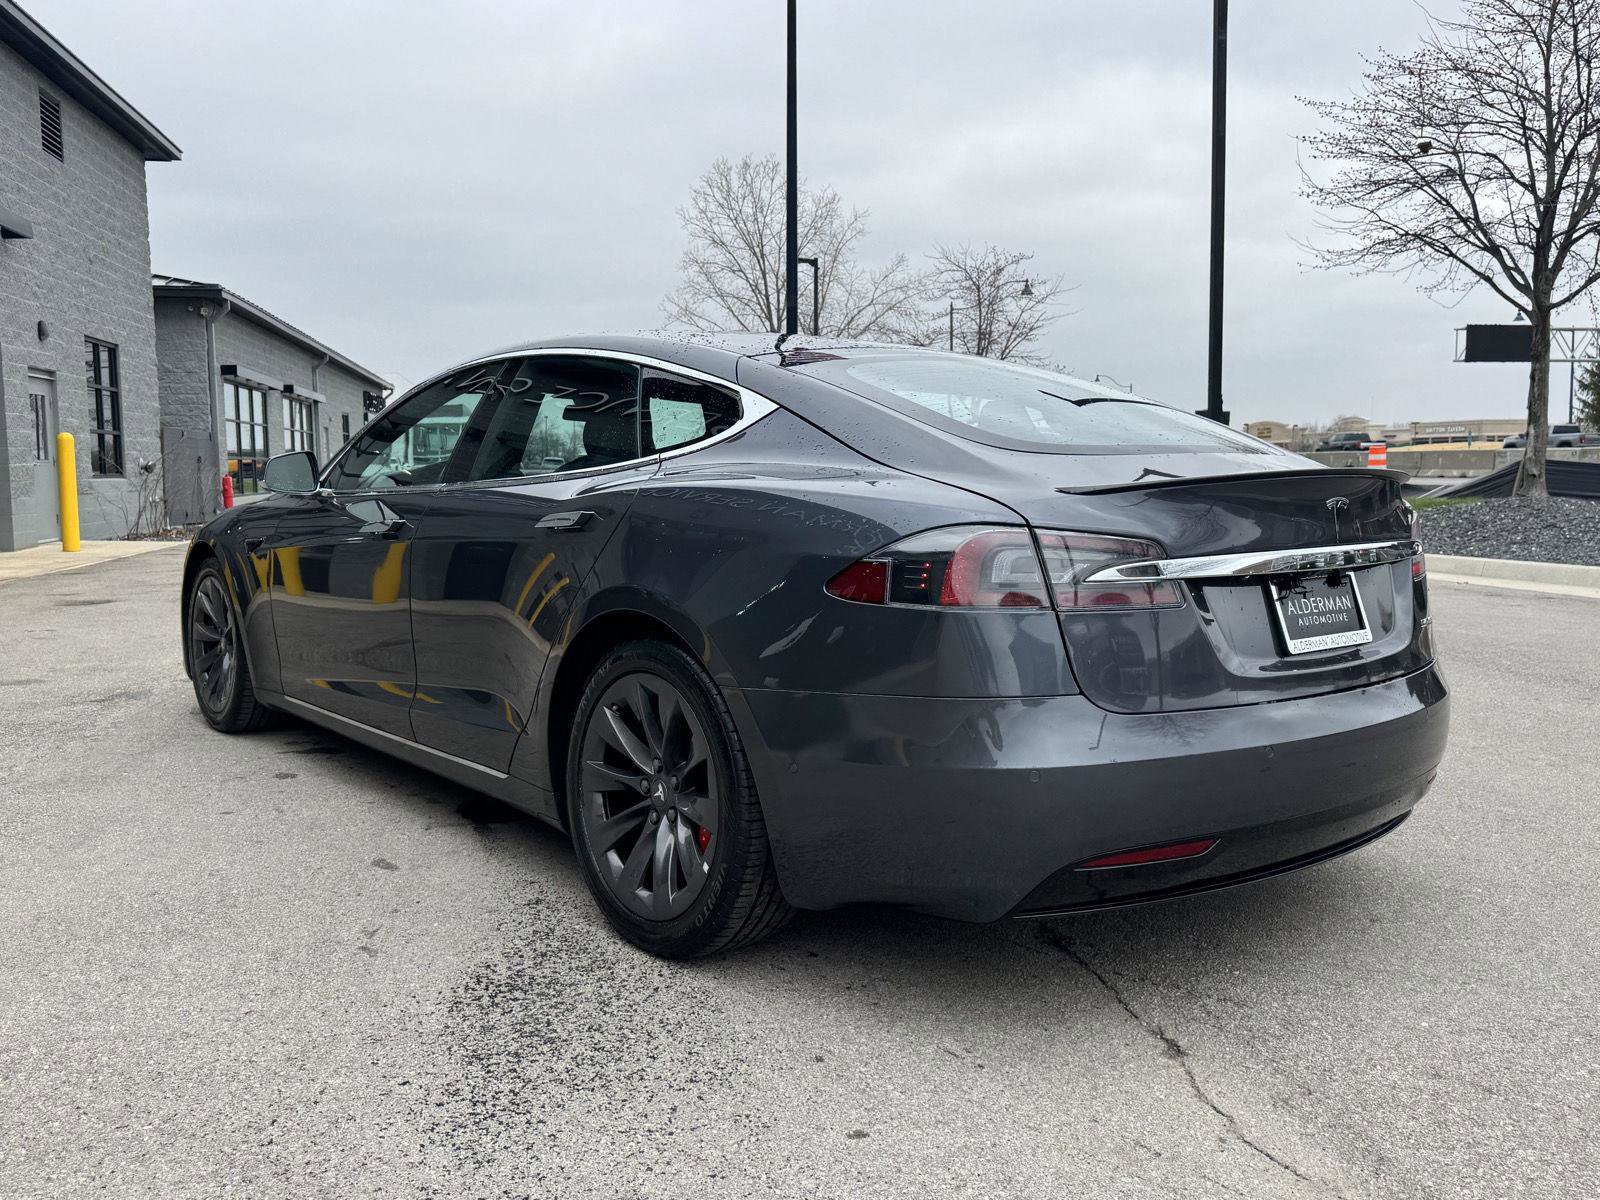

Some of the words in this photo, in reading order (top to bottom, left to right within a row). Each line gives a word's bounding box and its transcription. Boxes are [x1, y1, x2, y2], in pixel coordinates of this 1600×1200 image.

[1288, 595, 1352, 616] ALDERMAN
[1298, 612, 1349, 627] AUTOMOTIVE
[1292, 638, 1330, 653] ALDERMAN
[1330, 632, 1370, 648] AUTOMOTIVE
